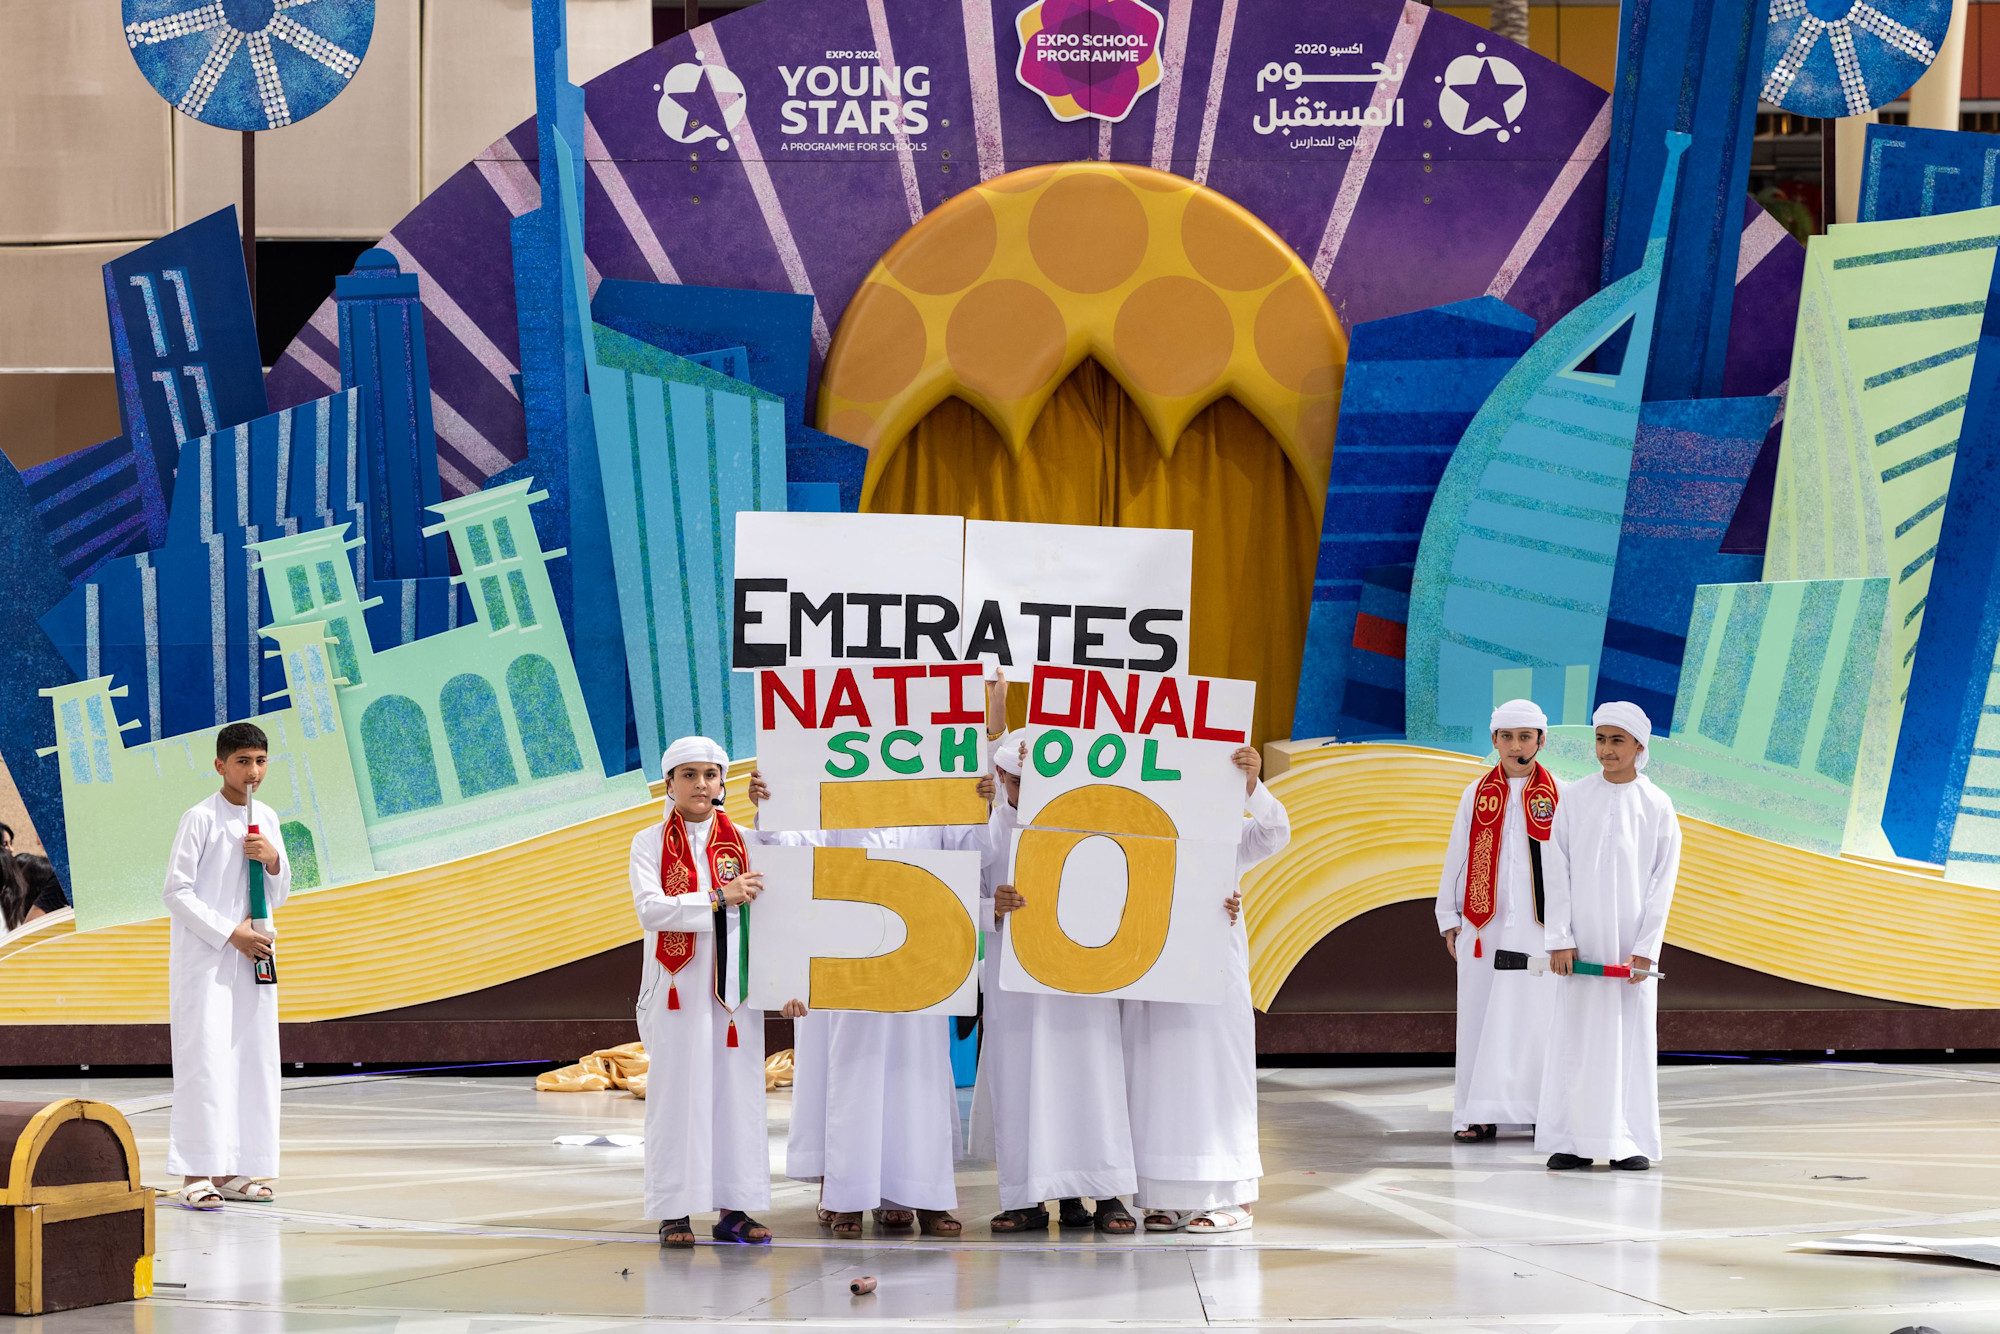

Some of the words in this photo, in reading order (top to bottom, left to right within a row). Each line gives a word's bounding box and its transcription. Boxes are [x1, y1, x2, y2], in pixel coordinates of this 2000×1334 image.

[1037, 34, 1079, 47] EXPO
[1082, 34, 1148, 47] SCHOOL
[825, 50, 854, 59] EXPO
[854, 50, 881, 59] 2020
[1294, 44, 1327, 54] 2020
[1329, 43, 1363, 57] اكسبو
[1037, 50, 1139, 62] PROGRAMME
[778, 65, 930, 97] YOUNG
[780, 100, 929, 135] STARS
[1252, 96, 1404, 136] المستقبل
[781, 142, 788, 151] A
[790, 142, 855, 151] PROGRAMME
[857, 142, 877, 151] FOR
[879, 142, 927, 152] SCHOOLS
[1289, 136, 1335, 149] للمدارس
[733, 578, 1183, 673] EMIRATES
[1478, 795, 1498, 812] 50
